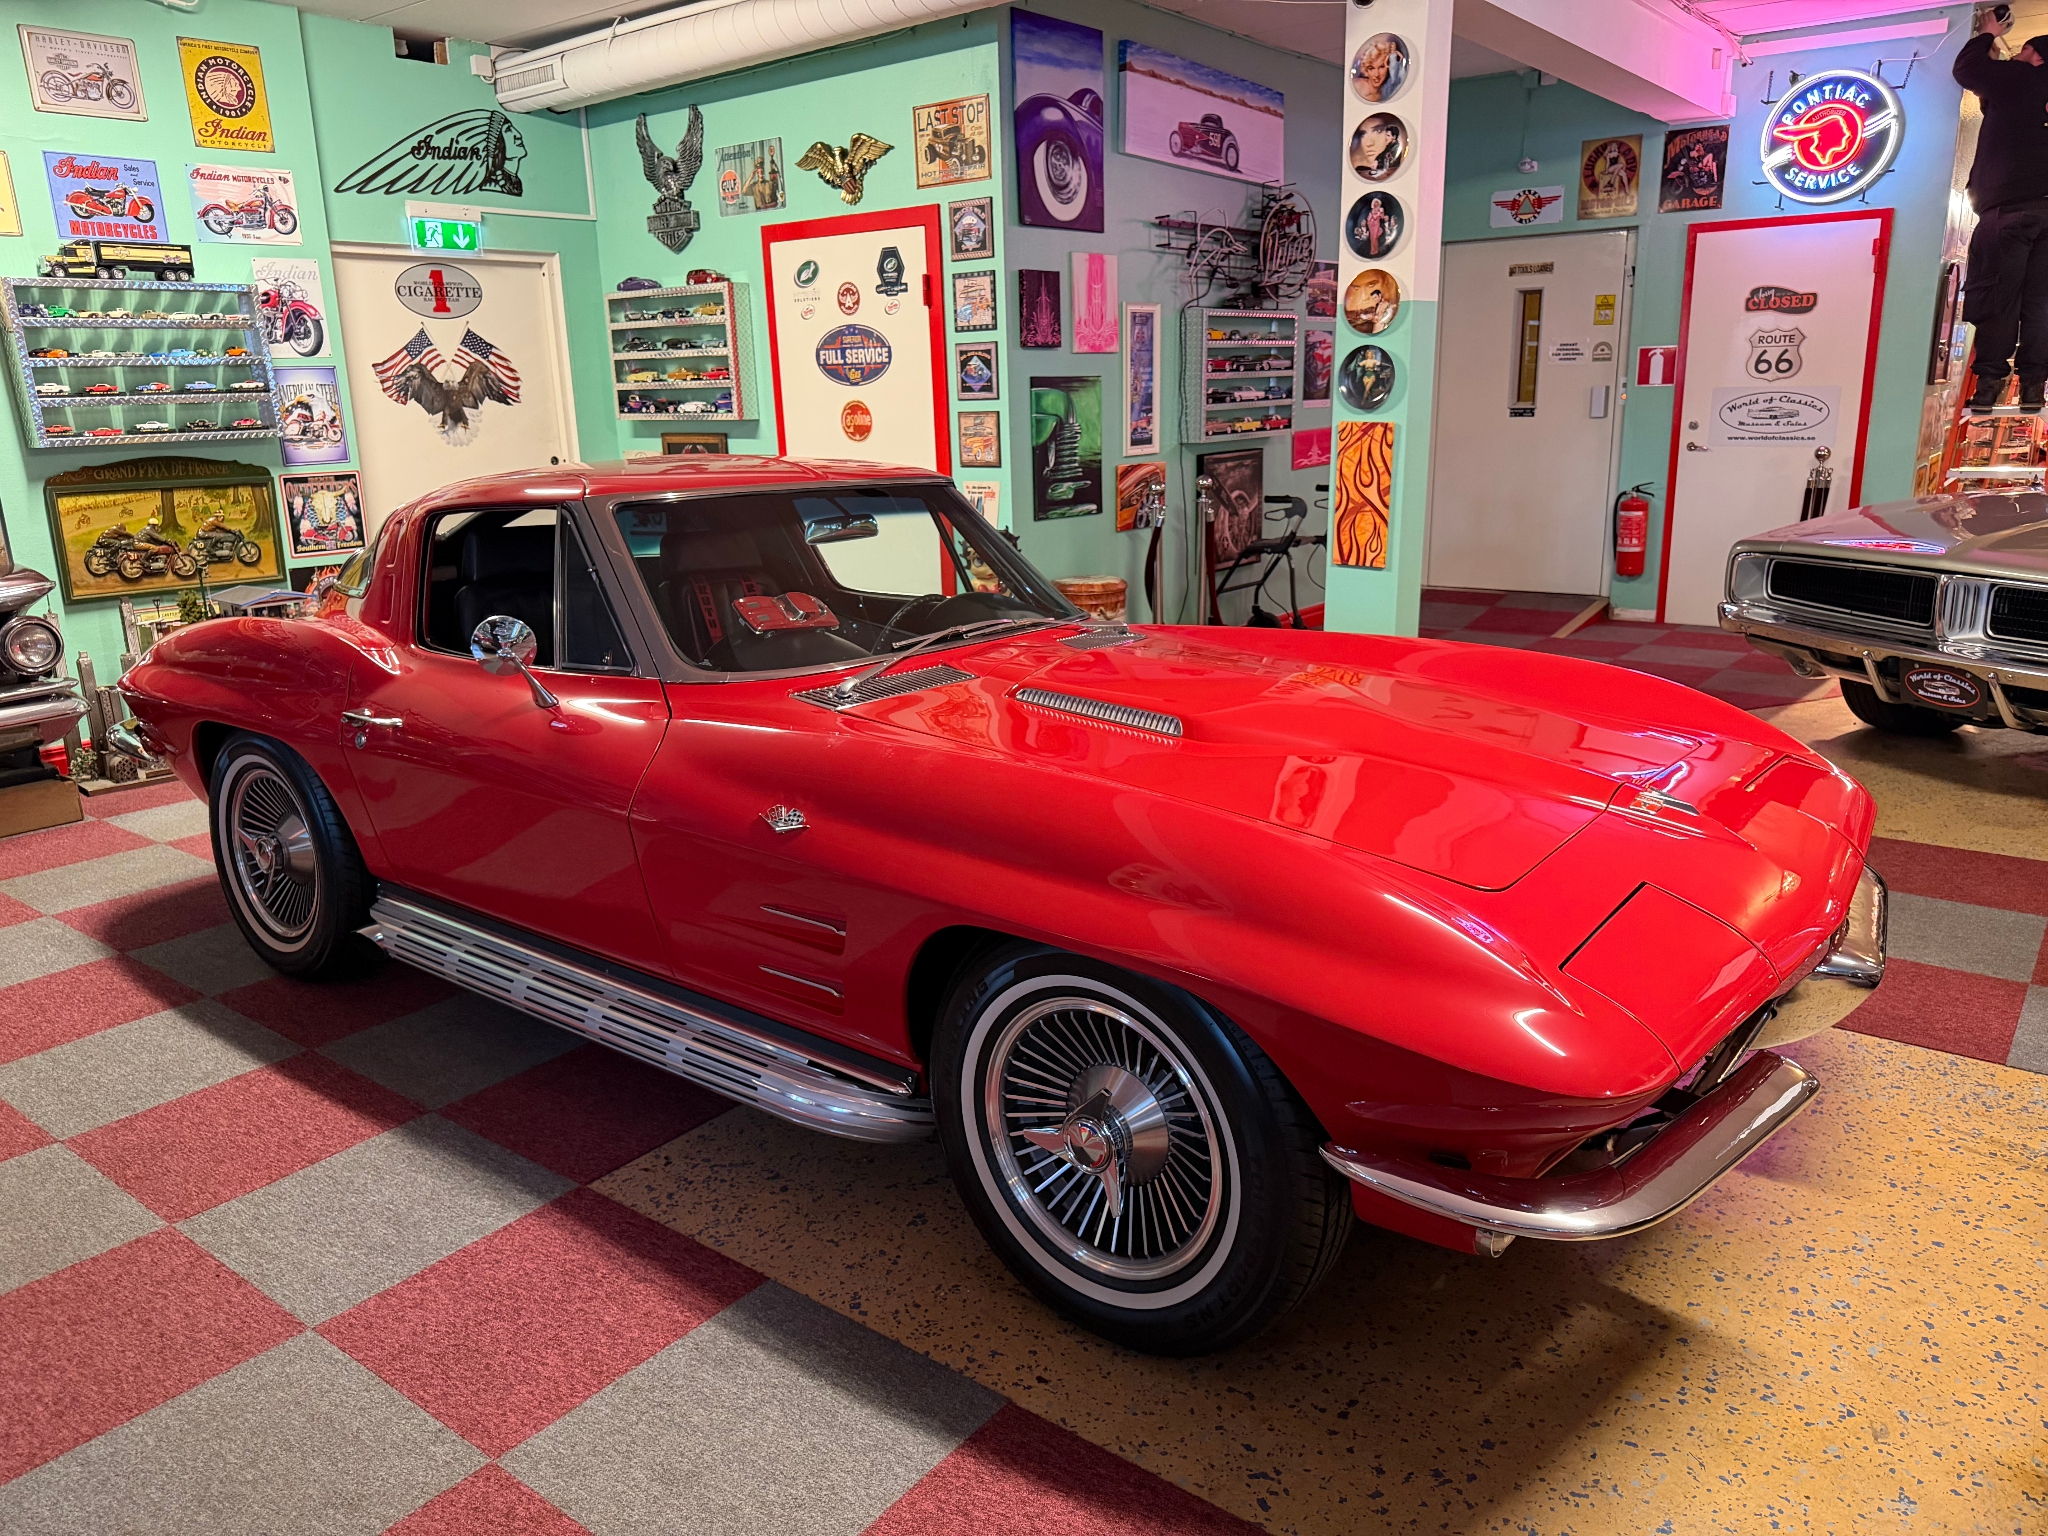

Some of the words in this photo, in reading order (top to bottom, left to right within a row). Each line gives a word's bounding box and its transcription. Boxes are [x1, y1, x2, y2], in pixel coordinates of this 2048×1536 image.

[196, 64, 211, 104] INDIAN
[208, 58, 254, 108] MOTORCYCLE
[219, 107, 241, 116] 1901
[1782, 84, 1871, 125] PONTIAC
[917, 108, 948, 132] LAST
[952, 102, 984, 124] STOP
[1811, 108, 1846, 122] AUTHORIZED
[198, 119, 268, 142] Indian
[202, 139, 267, 149] MOTORCYCLE
[410, 134, 482, 162] Indian
[53, 156, 119, 180] Indian
[124, 164, 139, 172] Sales
[1584, 142, 1608, 178] LUCKY
[132, 178, 155, 188] Service
[190, 167, 230, 181] Indian
[232, 175, 275, 185] MOTORCYCLES
[921, 170, 937, 178] HOT
[1784, 163, 1862, 190] SERVICE
[1662, 196, 1718, 210] GARAGE
[69, 220, 158, 240] MOTORCYCLES
[256, 262, 318, 281] Indian
[397, 286, 481, 298] CIGARETTE
[1748, 294, 1815, 310] CLOSED
[1758, 334, 1796, 344] ROUTE
[820, 348, 844, 364] FULL
[846, 347, 889, 364] SERVICE
[1754, 348, 1794, 374] 66
[1726, 398, 1759, 413] World
[1762, 396, 1778, 404] of
[1778, 395, 1824, 413] Classics
[842, 410, 872, 432] Gasoline
[93, 466, 136, 481] GRAND
[138, 462, 169, 478] PRIX
[171, 462, 186, 476] DE
[186, 462, 230, 476] FRANCE
[296, 544, 326, 553] Southern
[1909, 672, 1932, 683] World
[1943, 674, 1976, 696] Classics
[1918, 688, 1942, 700] Museum
[1948, 696, 1966, 704] Sales
